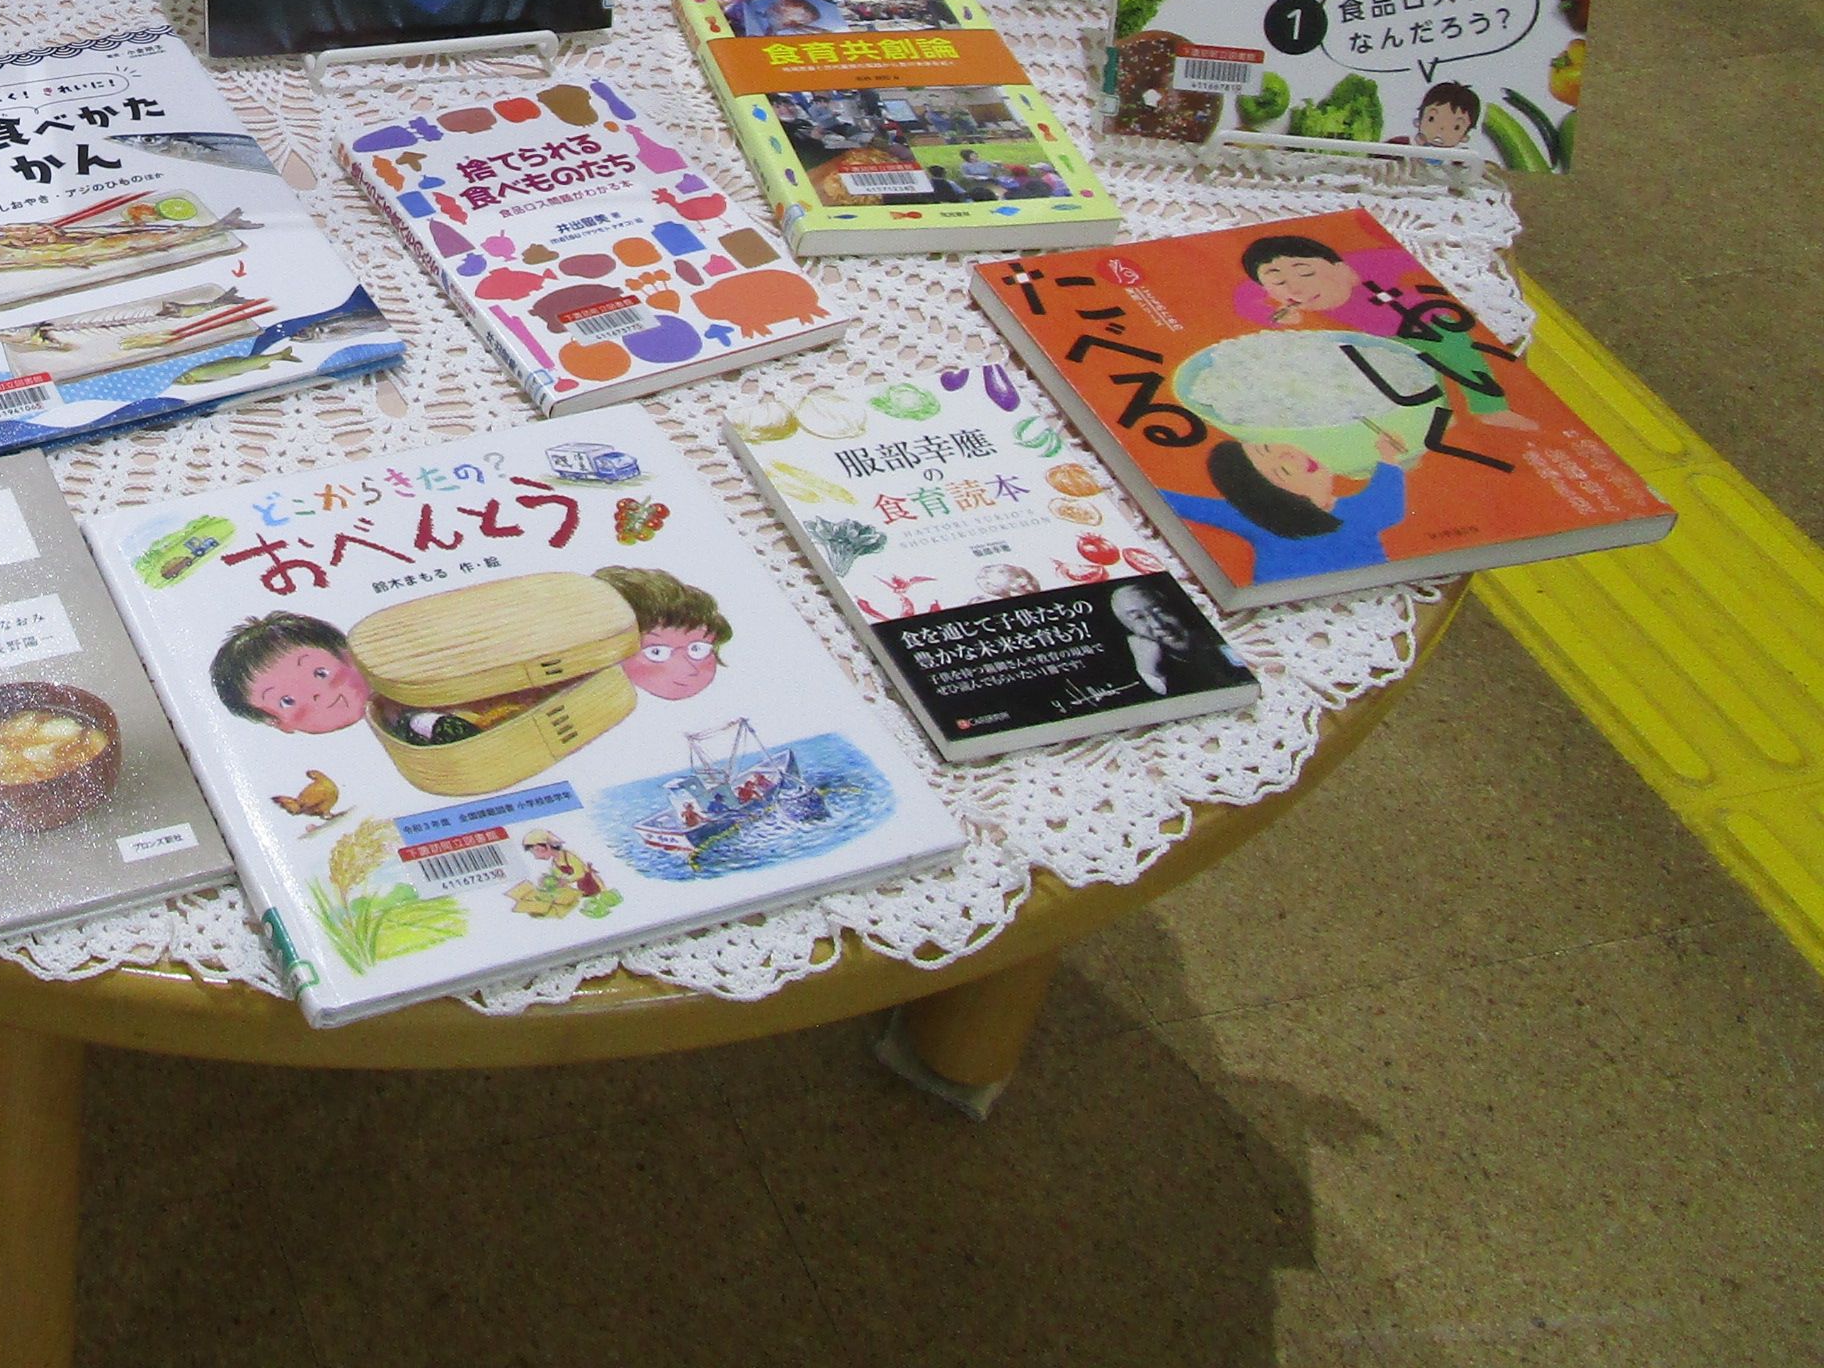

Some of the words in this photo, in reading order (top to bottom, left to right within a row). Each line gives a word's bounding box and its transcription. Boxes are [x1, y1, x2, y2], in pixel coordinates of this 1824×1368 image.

[762, 37, 961, 65] 食育共創論
[1348, 7, 1512, 55] なんだろう？
[456, 132, 604, 184] 捨てられる
[459, 153, 637, 212] 食べものたち
[499, 179, 634, 219] 食品ロス問題がわかる本
[1001, 262, 1210, 448] たべる
[834, 429, 998, 479] 服部幸應
[923, 468, 944, 482] の
[252, 452, 507, 527] どこからきたの？
[874, 473, 1031, 525] 食育読本
[220, 475, 580, 596] おべんとう
[372, 567, 449, 595] 鈴木まもる
[459, 556, 502, 575] 作・絵
[901, 600, 1094, 650] 食を通じて子供たちの
[913, 620, 1093, 669] 豊かな未来を育もう！
